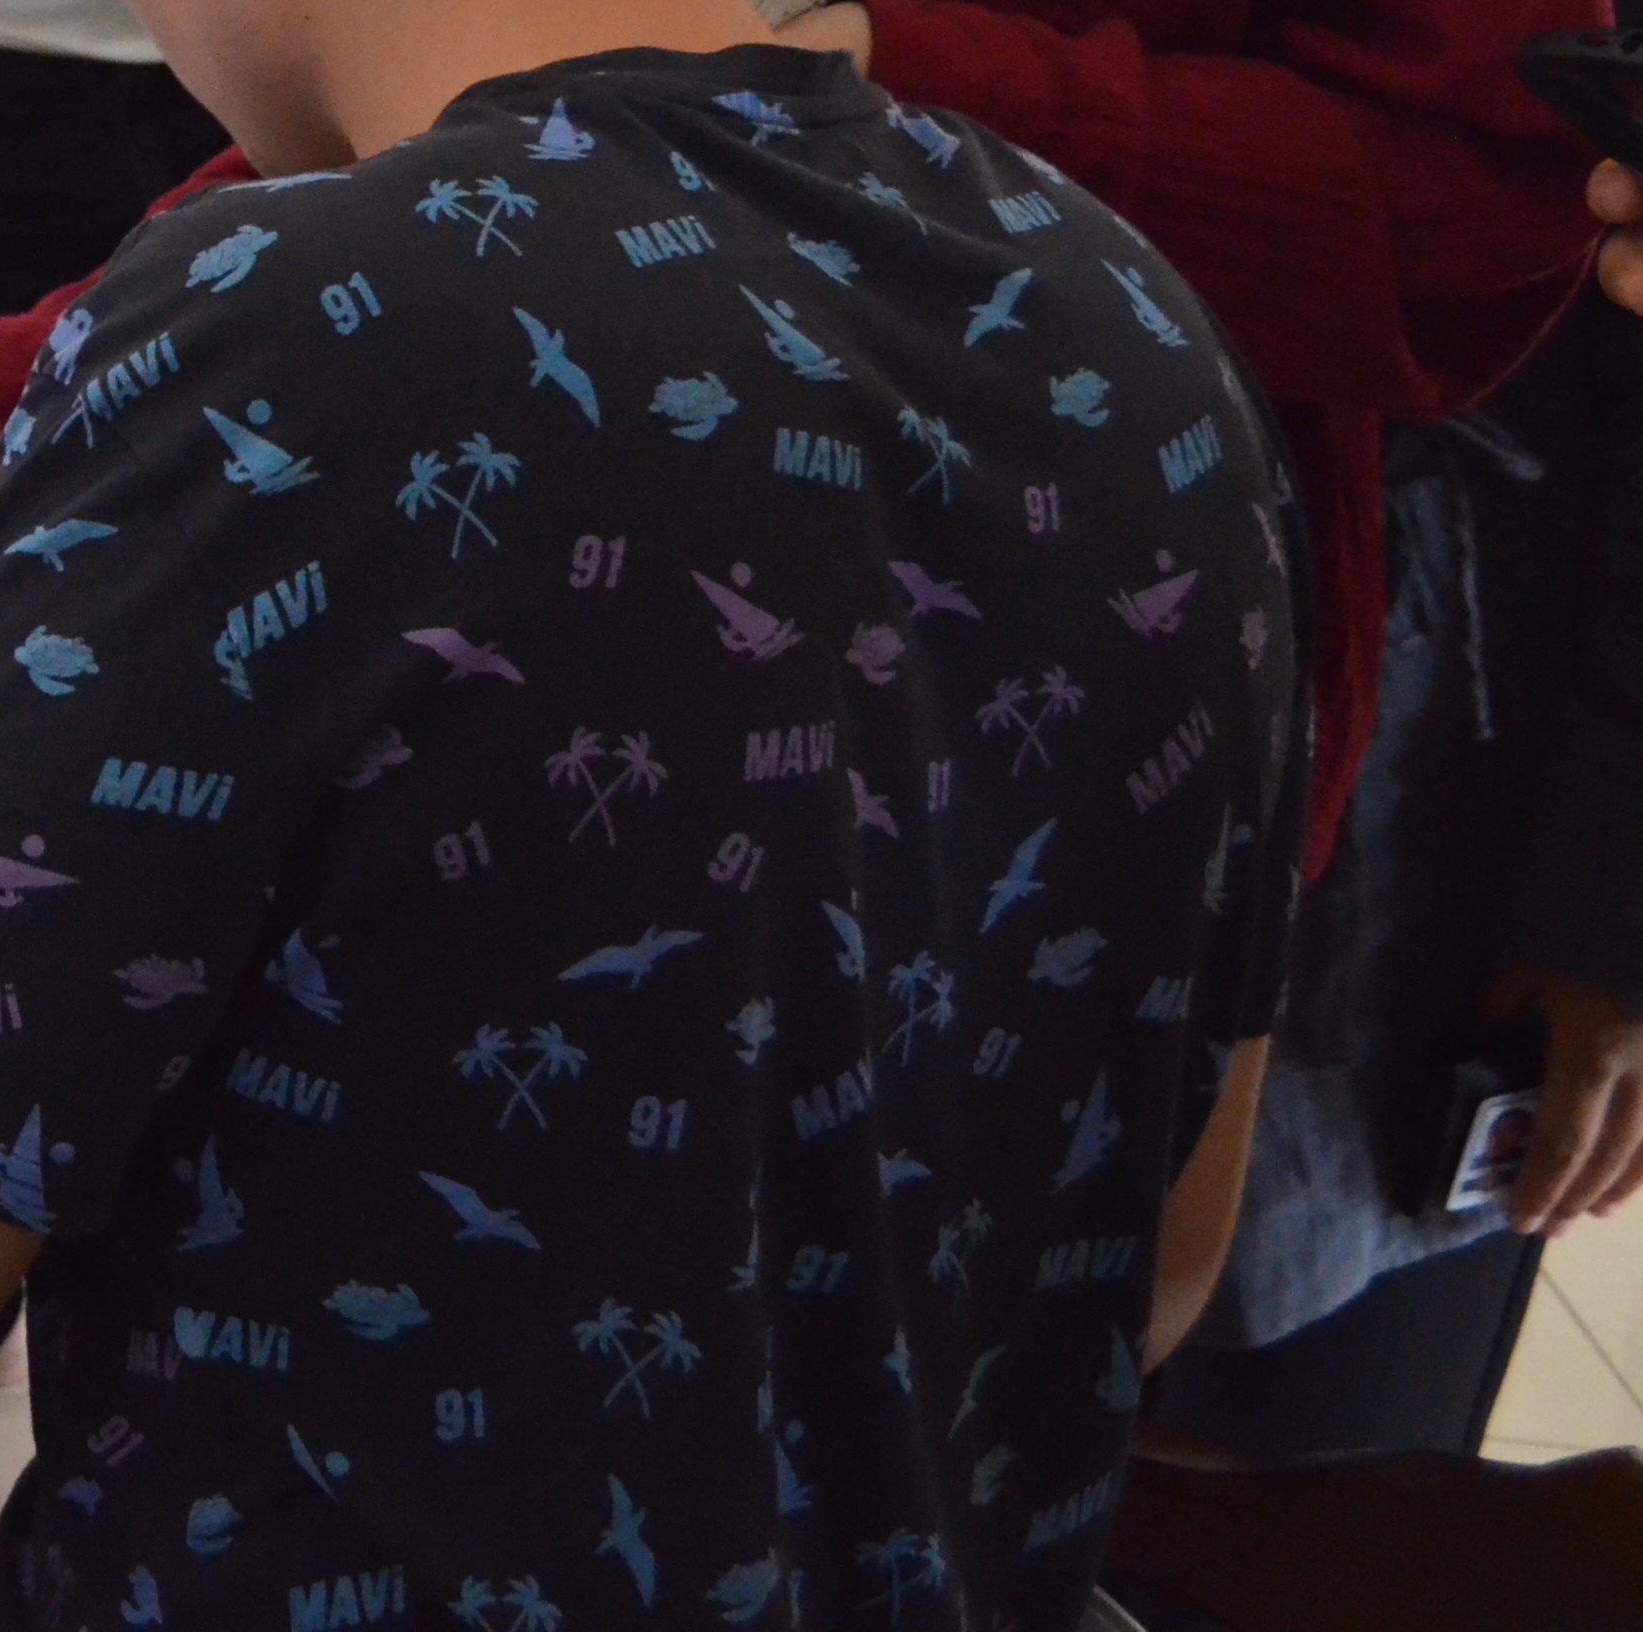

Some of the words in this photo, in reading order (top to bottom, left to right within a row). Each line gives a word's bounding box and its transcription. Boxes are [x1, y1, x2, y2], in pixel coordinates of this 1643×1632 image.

[321, 270, 383, 337] 91
[1023, 482, 1061, 534] 91
[568, 534, 628, 590] 91
[432, 820, 493, 882] 91
[706, 832, 767, 894] 91
[972, 1026, 1022, 1079] 91
[629, 1094, 689, 1152] 91
[434, 1386, 488, 1443] 91
